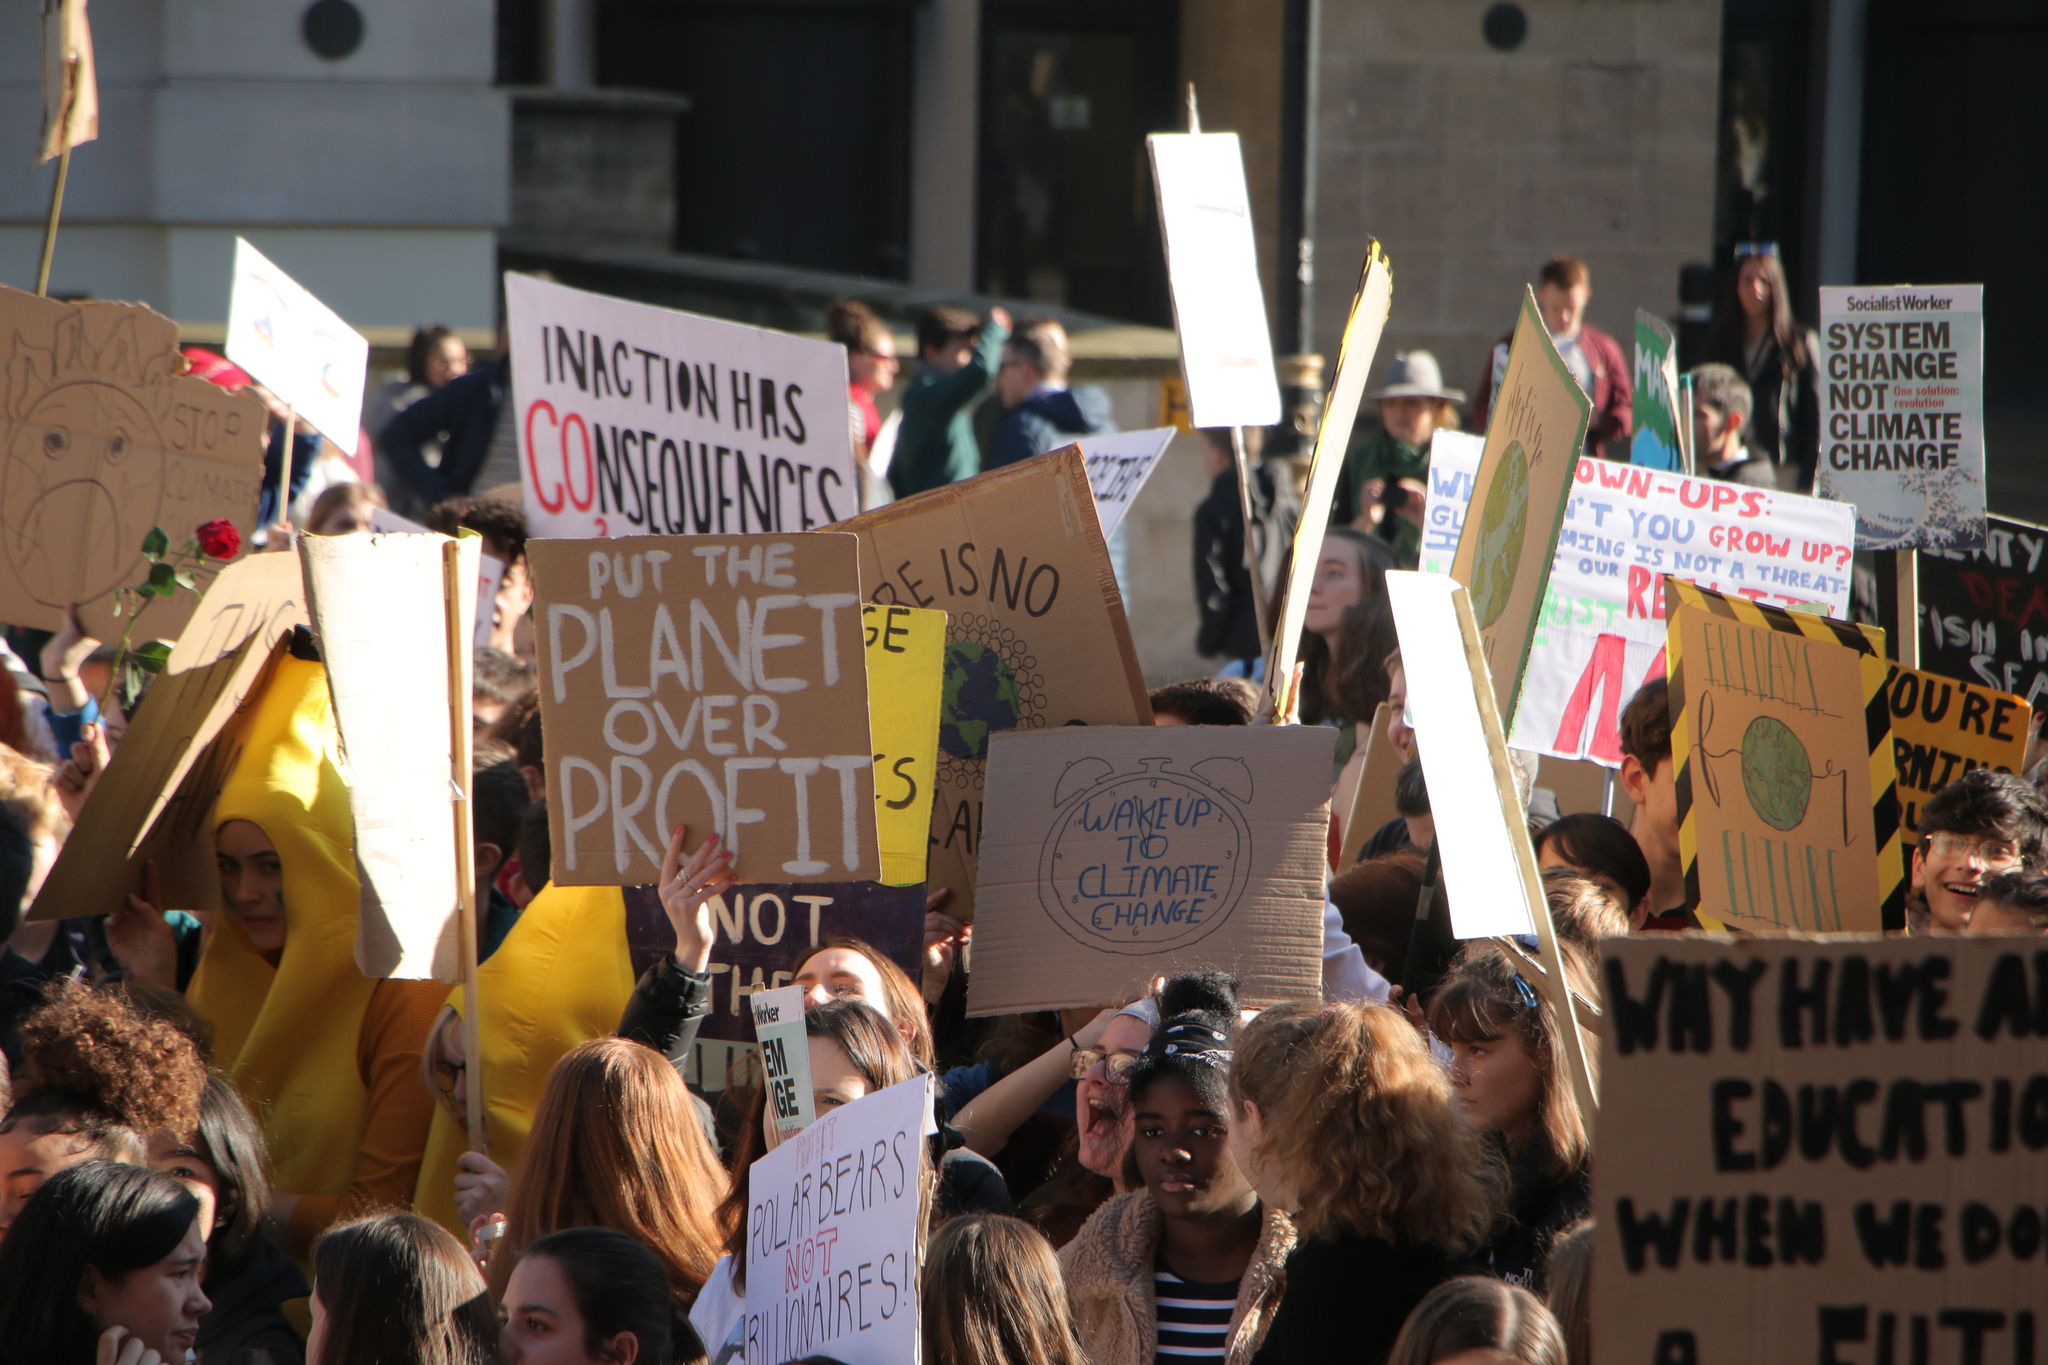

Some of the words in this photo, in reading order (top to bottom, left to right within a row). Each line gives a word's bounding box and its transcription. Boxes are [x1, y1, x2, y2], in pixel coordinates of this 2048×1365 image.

[1847, 295, 1901, 311] Socialist
[1902, 295, 1953, 311] Worker
[1827, 322, 1950, 350] SYSTEM
[543, 326, 719, 423] INACTION
[730, 370, 806, 445] HAS
[1828, 352, 1957, 380] CHANGE
[1829, 384, 1888, 410] NOT
[1894, 386, 1912, 396] One
[1916, 386, 1959, 396] solution:
[1894, 398, 1944, 409] revolution
[171, 403, 243, 450] STOP
[1829, 413, 1961, 440] CLIMATE
[1829, 443, 1958, 471] CHANGE
[1628, 509, 1695, 544] YOU
[1709, 526, 1790, 557] GROW
[1802, 541, 1851, 571] UP?
[1635, 545, 1664, 566] IS
[1674, 552, 1721, 574] NOT
[1729, 561, 1744, 580] A
[589, 550, 671, 599] PUT
[692, 543, 797, 589] THE
[940, 542, 979, 597] IS
[989, 547, 1060, 618] NO
[1579, 558, 1618, 577] OUR
[547, 593, 859, 703] PLANET
[603, 695, 787, 756] OVER
[559, 754, 874, 877] PROFIT
[1117, 834, 1169, 863] TO
[1078, 863, 1219, 899] CLIMATE
[707, 893, 834, 948] NOT
[1091, 898, 1207, 931] CHANGE
[1604, 955, 1767, 1056] WHY
[1777, 954, 1958, 1048] HAVE
[752, 1173, 811, 1264] POLAR
[818, 1131, 905, 1225] BEARS
[1615, 1193, 1825, 1275] WHEN
[1852, 1199, 1945, 1270] WE
[785, 1227, 838, 1294] NOT
